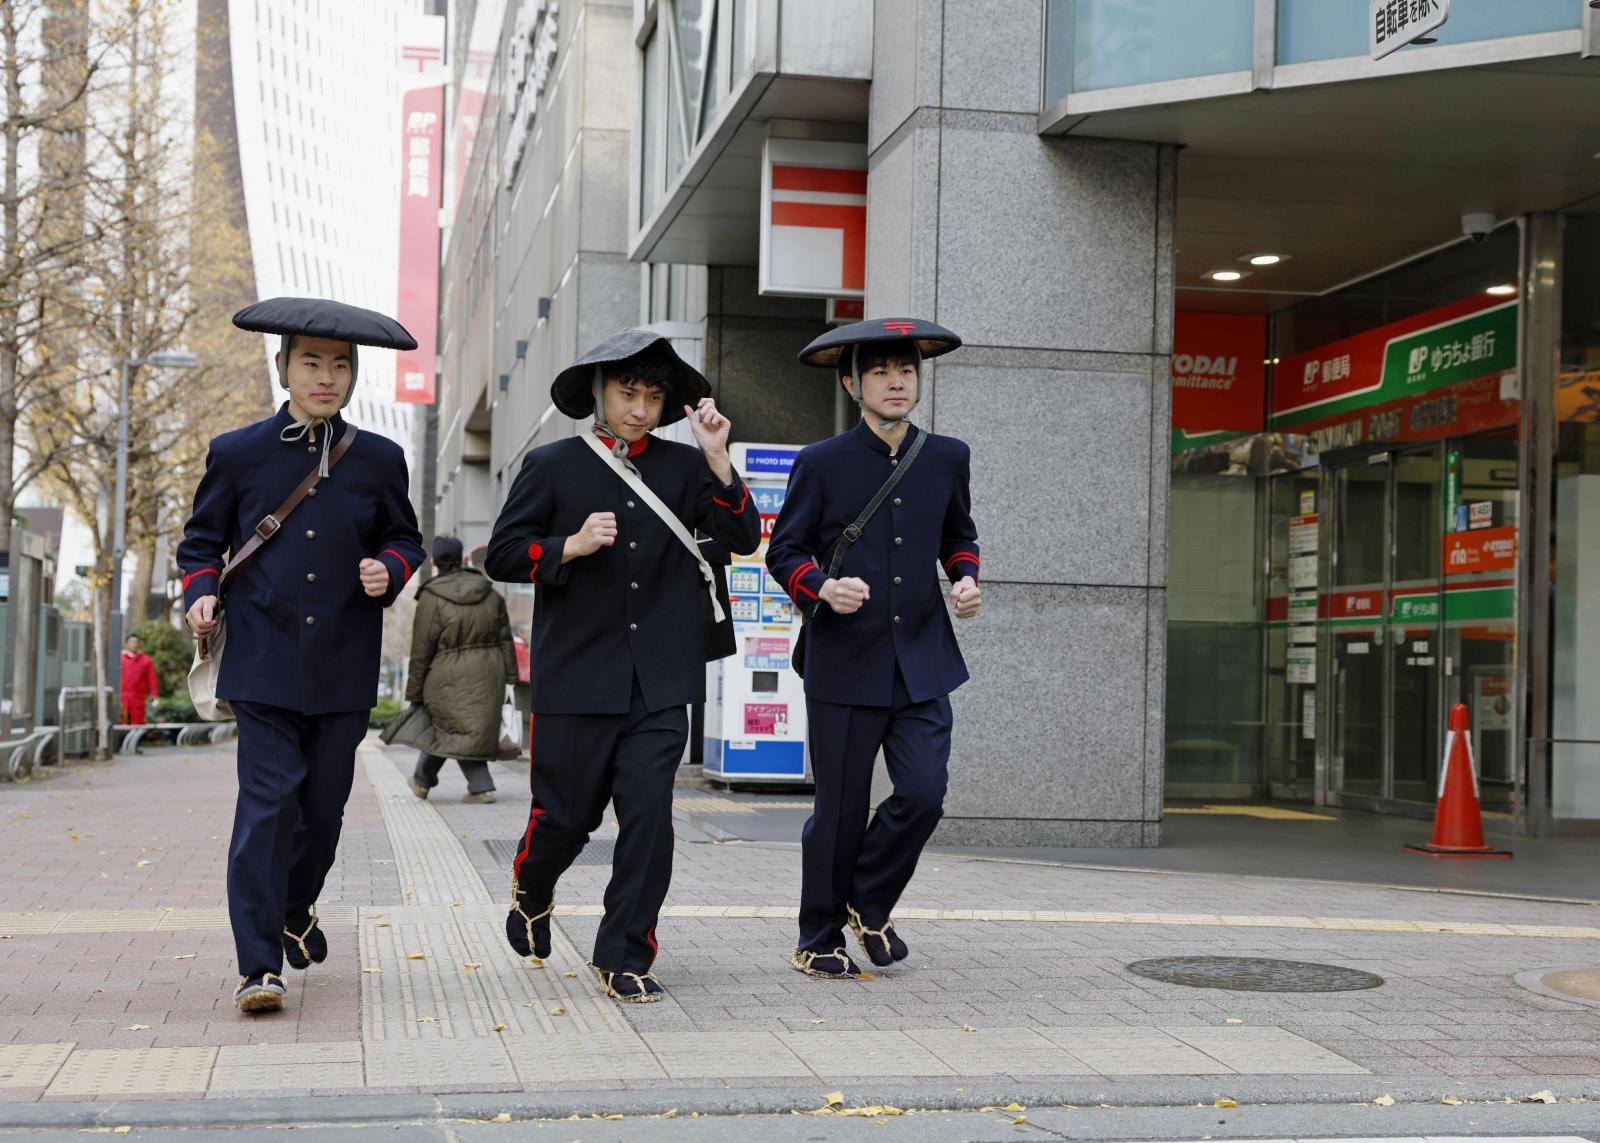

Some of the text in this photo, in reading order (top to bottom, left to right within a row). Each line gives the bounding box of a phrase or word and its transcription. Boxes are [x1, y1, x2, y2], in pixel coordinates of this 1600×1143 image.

[1430, 330, 1496, 373] ゆうちょ銀行
[1322, 354, 1350, 384] 郵便局
[755, 457, 779, 465] PHOTO
